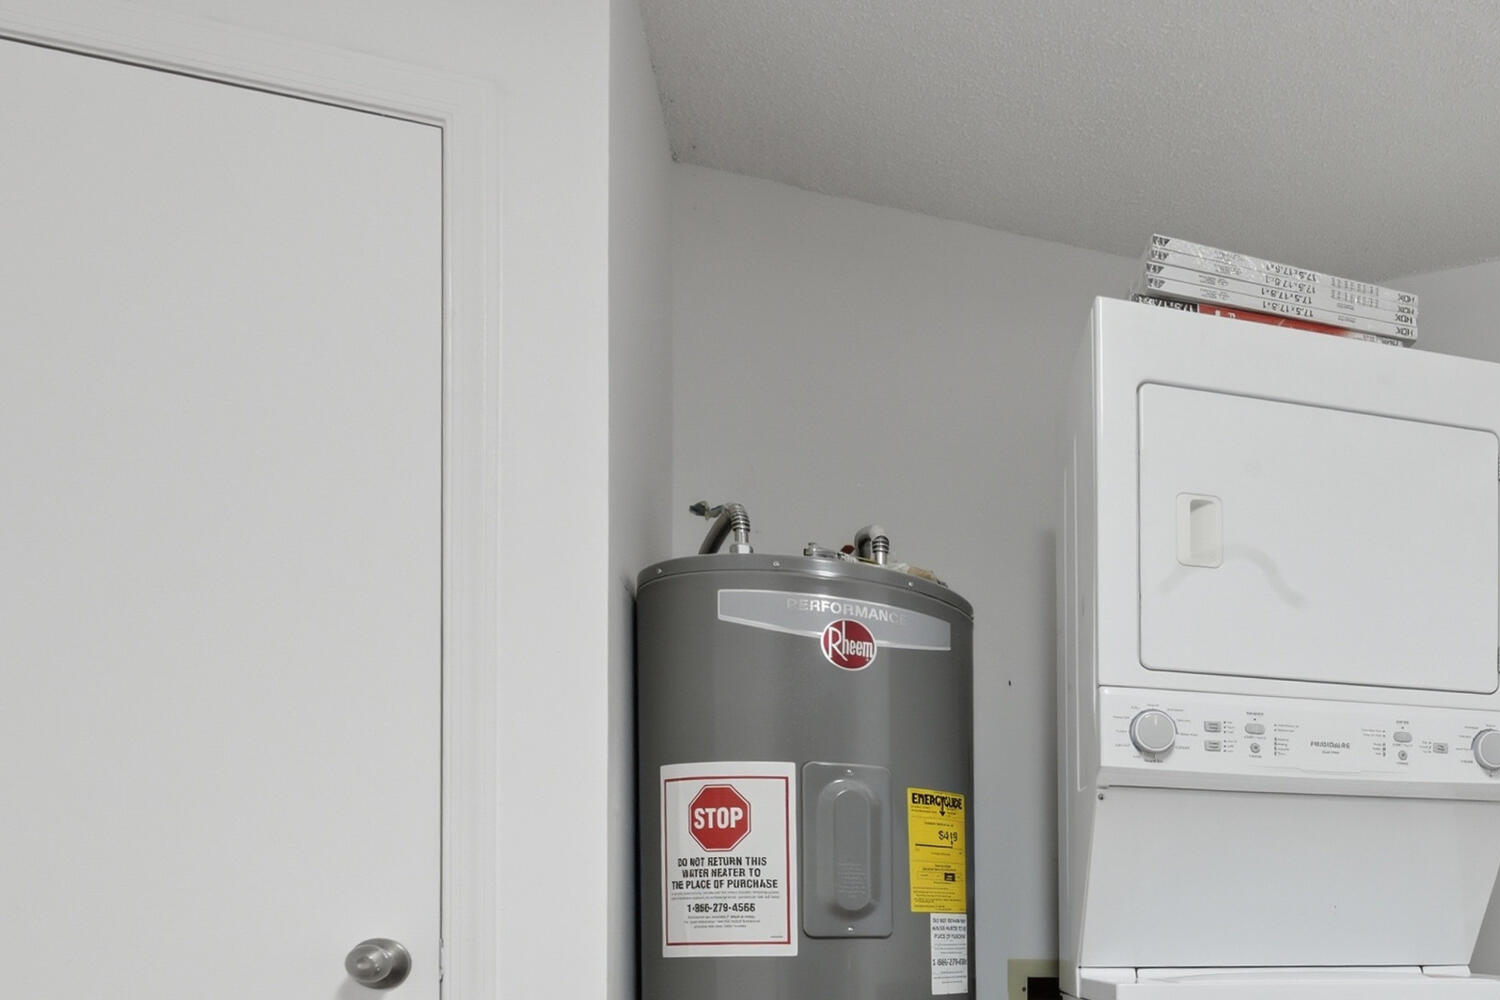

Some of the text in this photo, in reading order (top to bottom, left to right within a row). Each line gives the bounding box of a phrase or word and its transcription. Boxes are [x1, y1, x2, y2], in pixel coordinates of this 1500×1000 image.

[828, 620, 873, 661] Rheem
[693, 806, 744, 829] STOP
[677, 856, 767, 867] DO NOT RETURN THIS
[682, 868, 761, 878] WATER HEATER TO
[672, 879, 778, 890] THE PLACE OF PURCHASE
